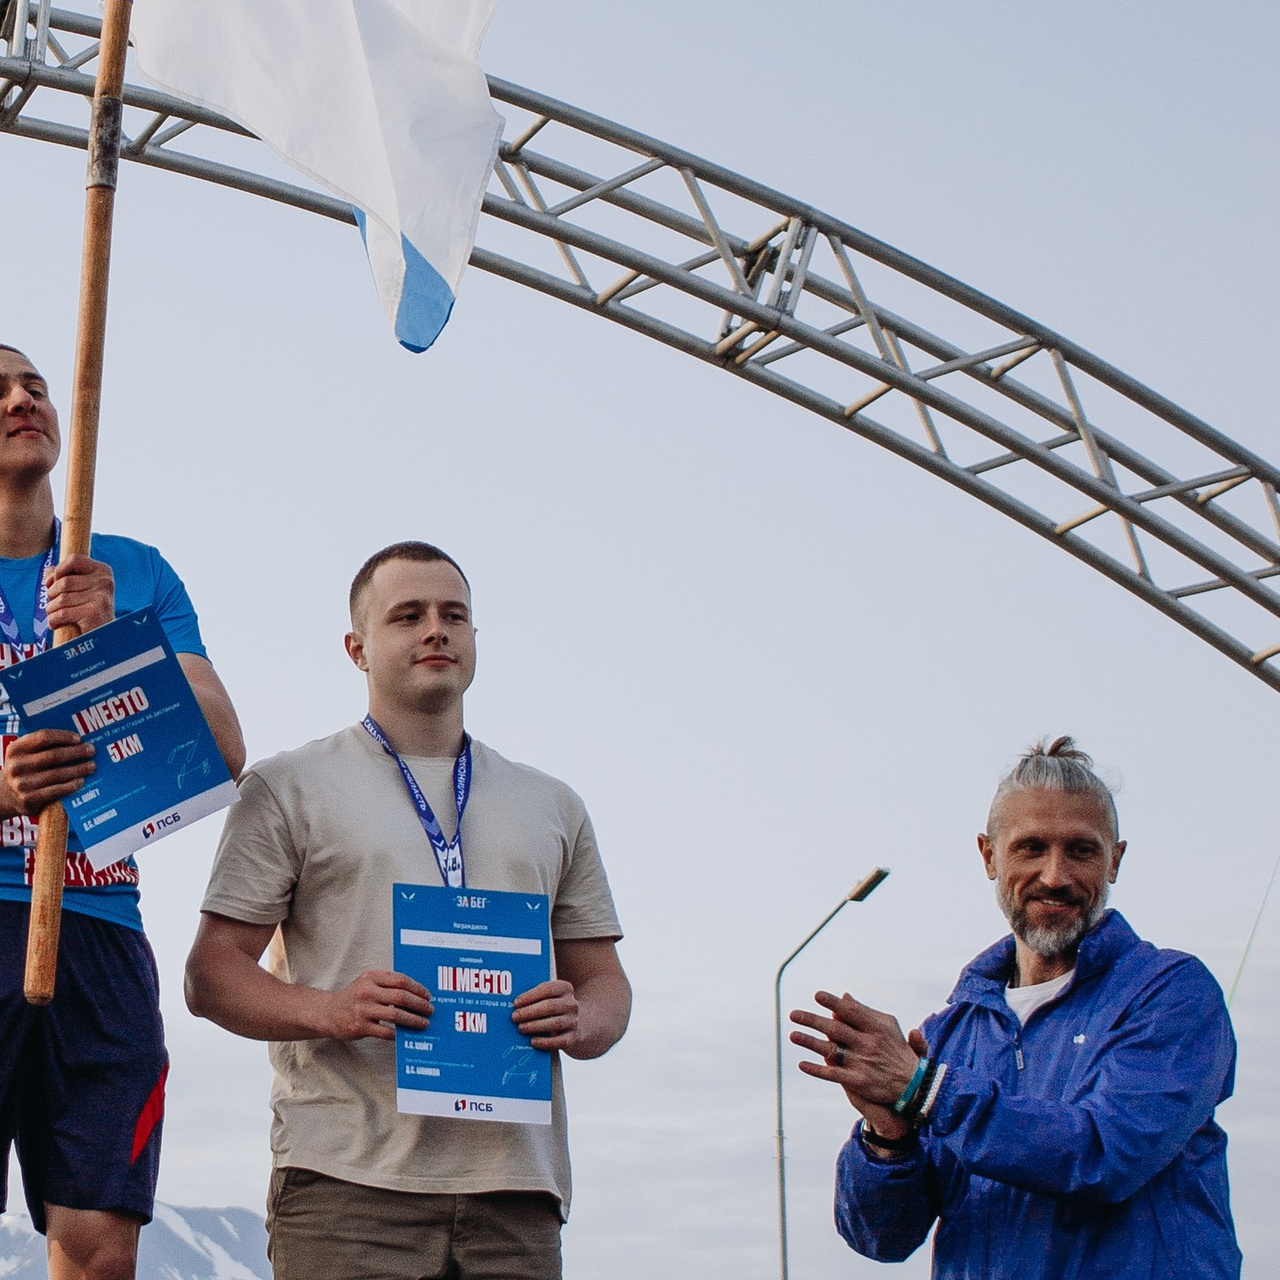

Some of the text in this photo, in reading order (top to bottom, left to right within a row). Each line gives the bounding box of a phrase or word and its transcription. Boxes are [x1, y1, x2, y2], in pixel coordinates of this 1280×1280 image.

[81, 686, 150, 734] МЕСТО
[106, 743, 121, 764] 5
[118, 732, 145, 760] КМ
[156, 812, 181, 831] ПСБ
[456, 968, 513, 995] МЕСТО
[455, 1011, 487, 1033] 5 КМ
[469, 1101, 493, 1113] ПСБ
